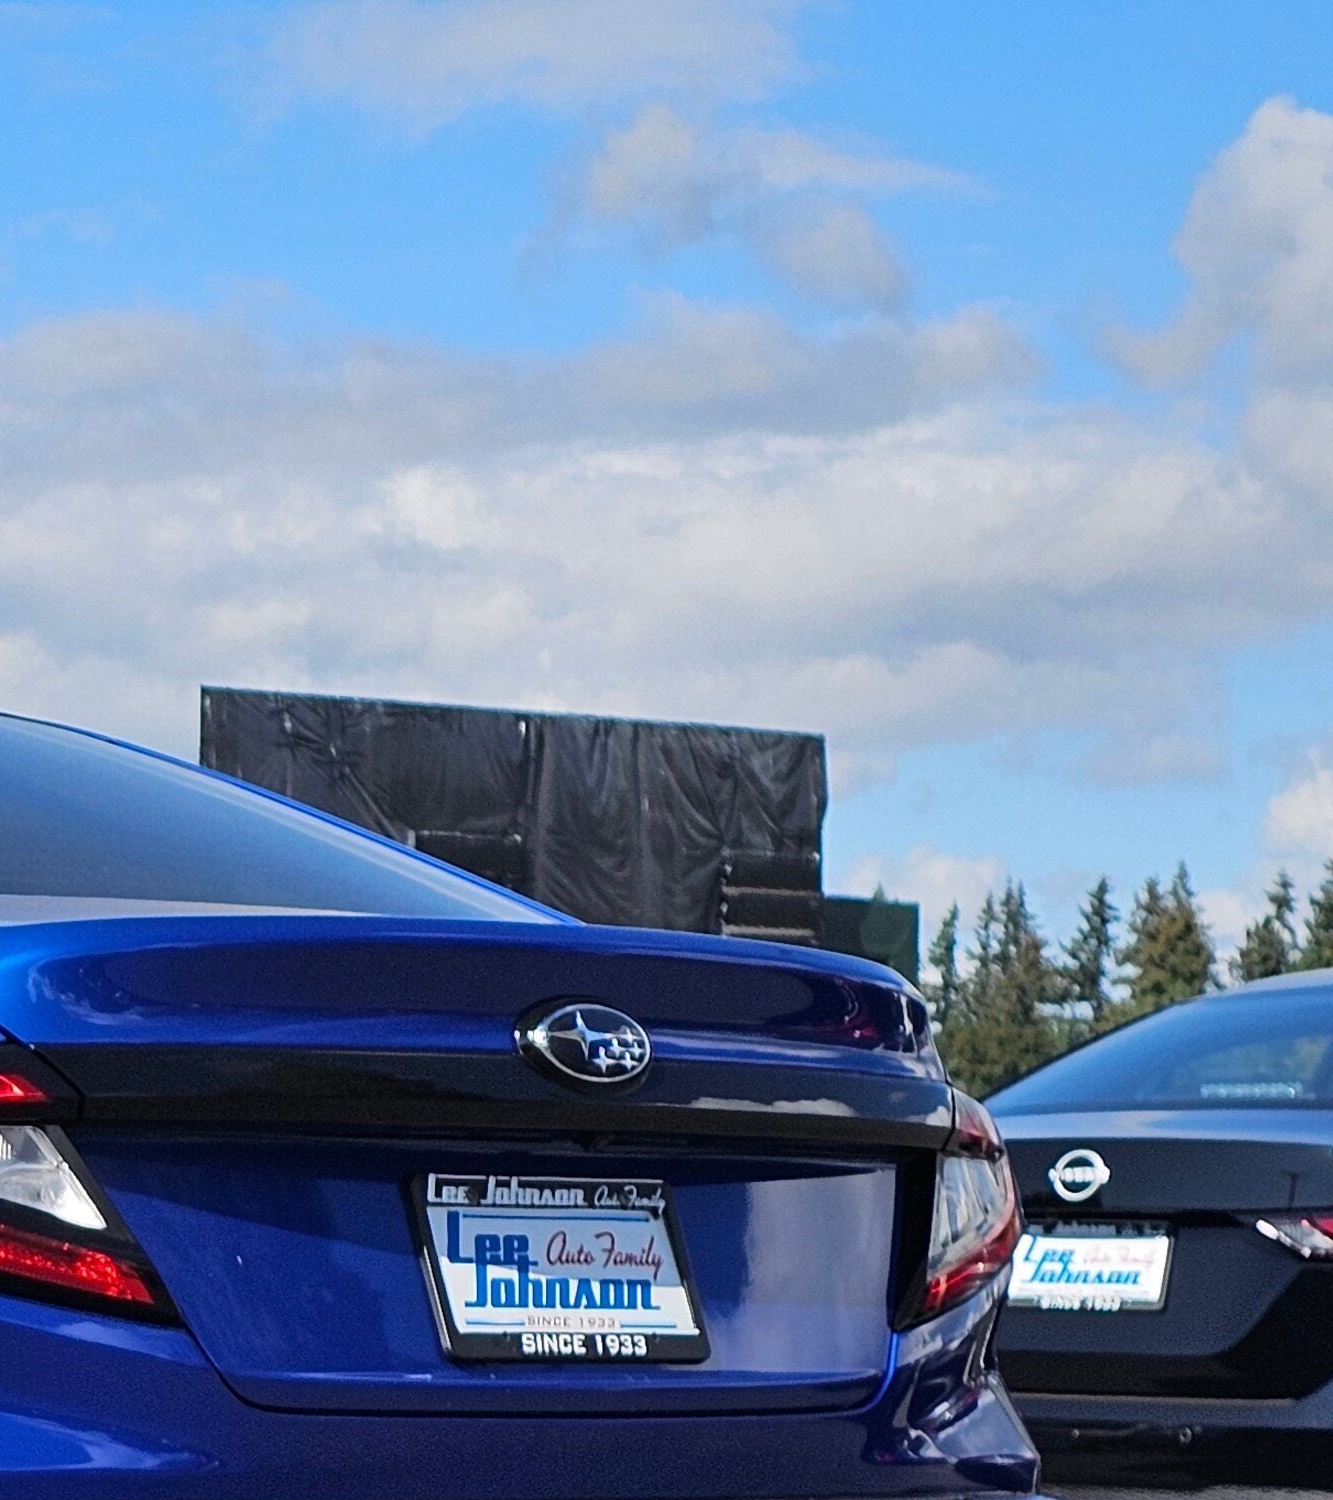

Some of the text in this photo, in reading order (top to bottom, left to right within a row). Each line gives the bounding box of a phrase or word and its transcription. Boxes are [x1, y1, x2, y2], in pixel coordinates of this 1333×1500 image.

[480, 1175, 589, 1207] Johnson
[446, 1210, 663, 1282] Lee Auto Family
[464, 1255, 662, 1311] Johnson
[526, 1315, 617, 1329] SINCE 1933
[521, 1331, 648, 1357] SINCE 1933
